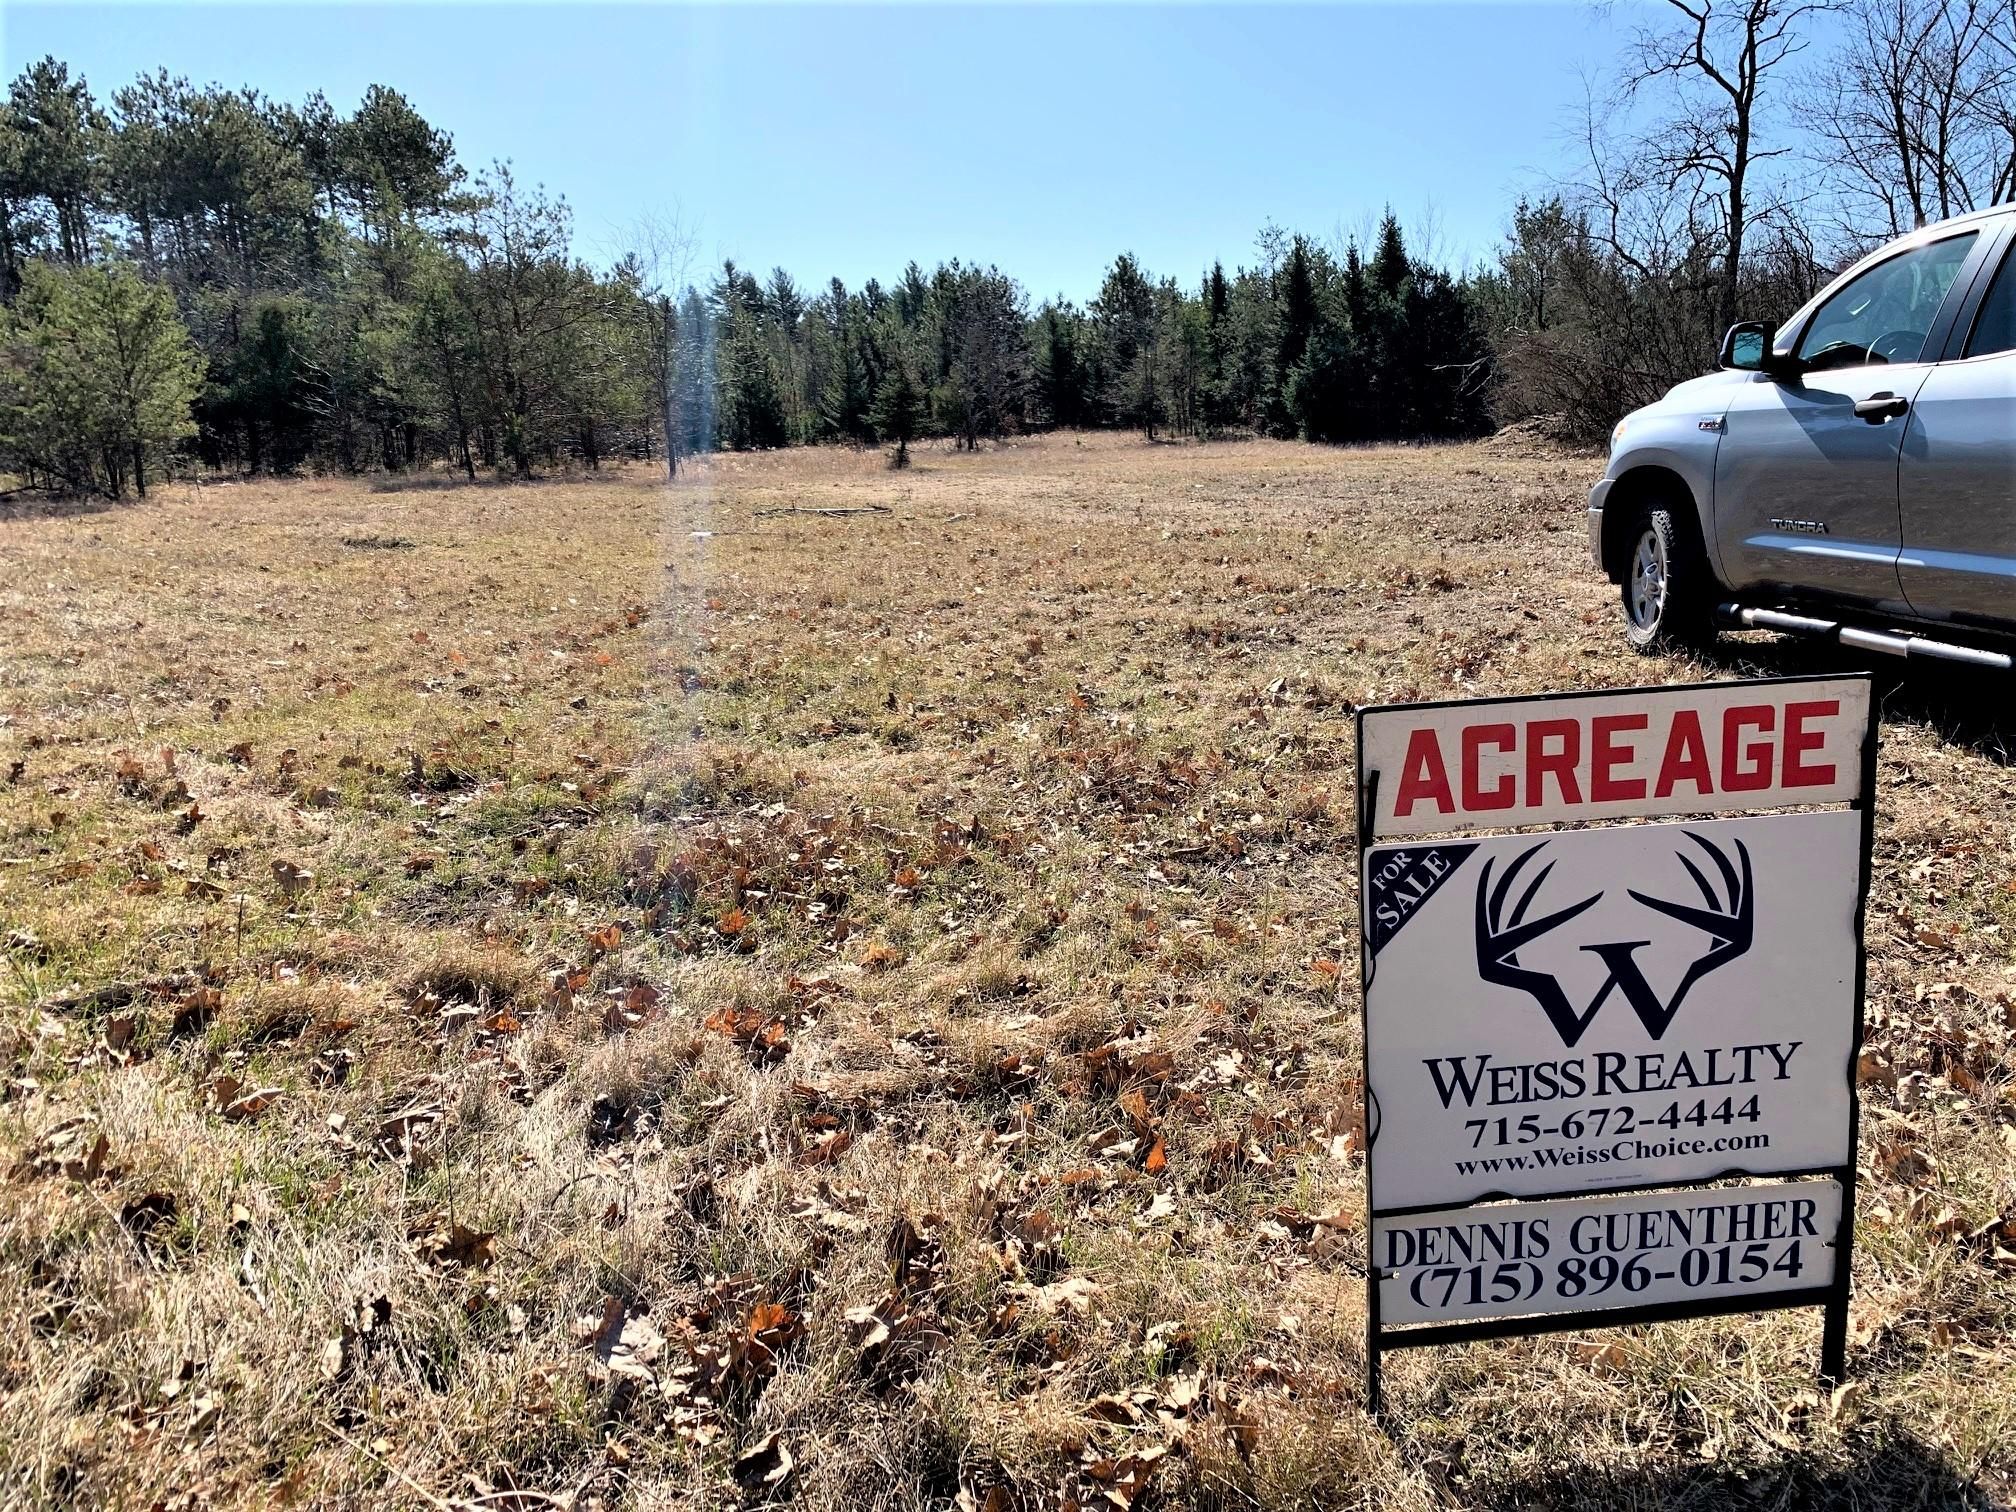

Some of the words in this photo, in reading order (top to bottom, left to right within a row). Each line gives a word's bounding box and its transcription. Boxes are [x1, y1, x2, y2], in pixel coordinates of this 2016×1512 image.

[1770, 517, 1828, 534] TUNDRA
[1393, 700, 1840, 816] ACREAGE
[1371, 851, 1412, 891] FOR
[1376, 850, 1451, 929] SALE
[1464, 1095, 1761, 1148] 715-672-4444
[1455, 1131, 1770, 1177] www.WeissChoice.com
[1384, 1219, 1550, 1269] DENNIS
[1569, 1199, 1820, 1254] GUENTHER
[1409, 1260, 1544, 1308] (715)
[1556, 1240, 1804, 1298] 896-0154
